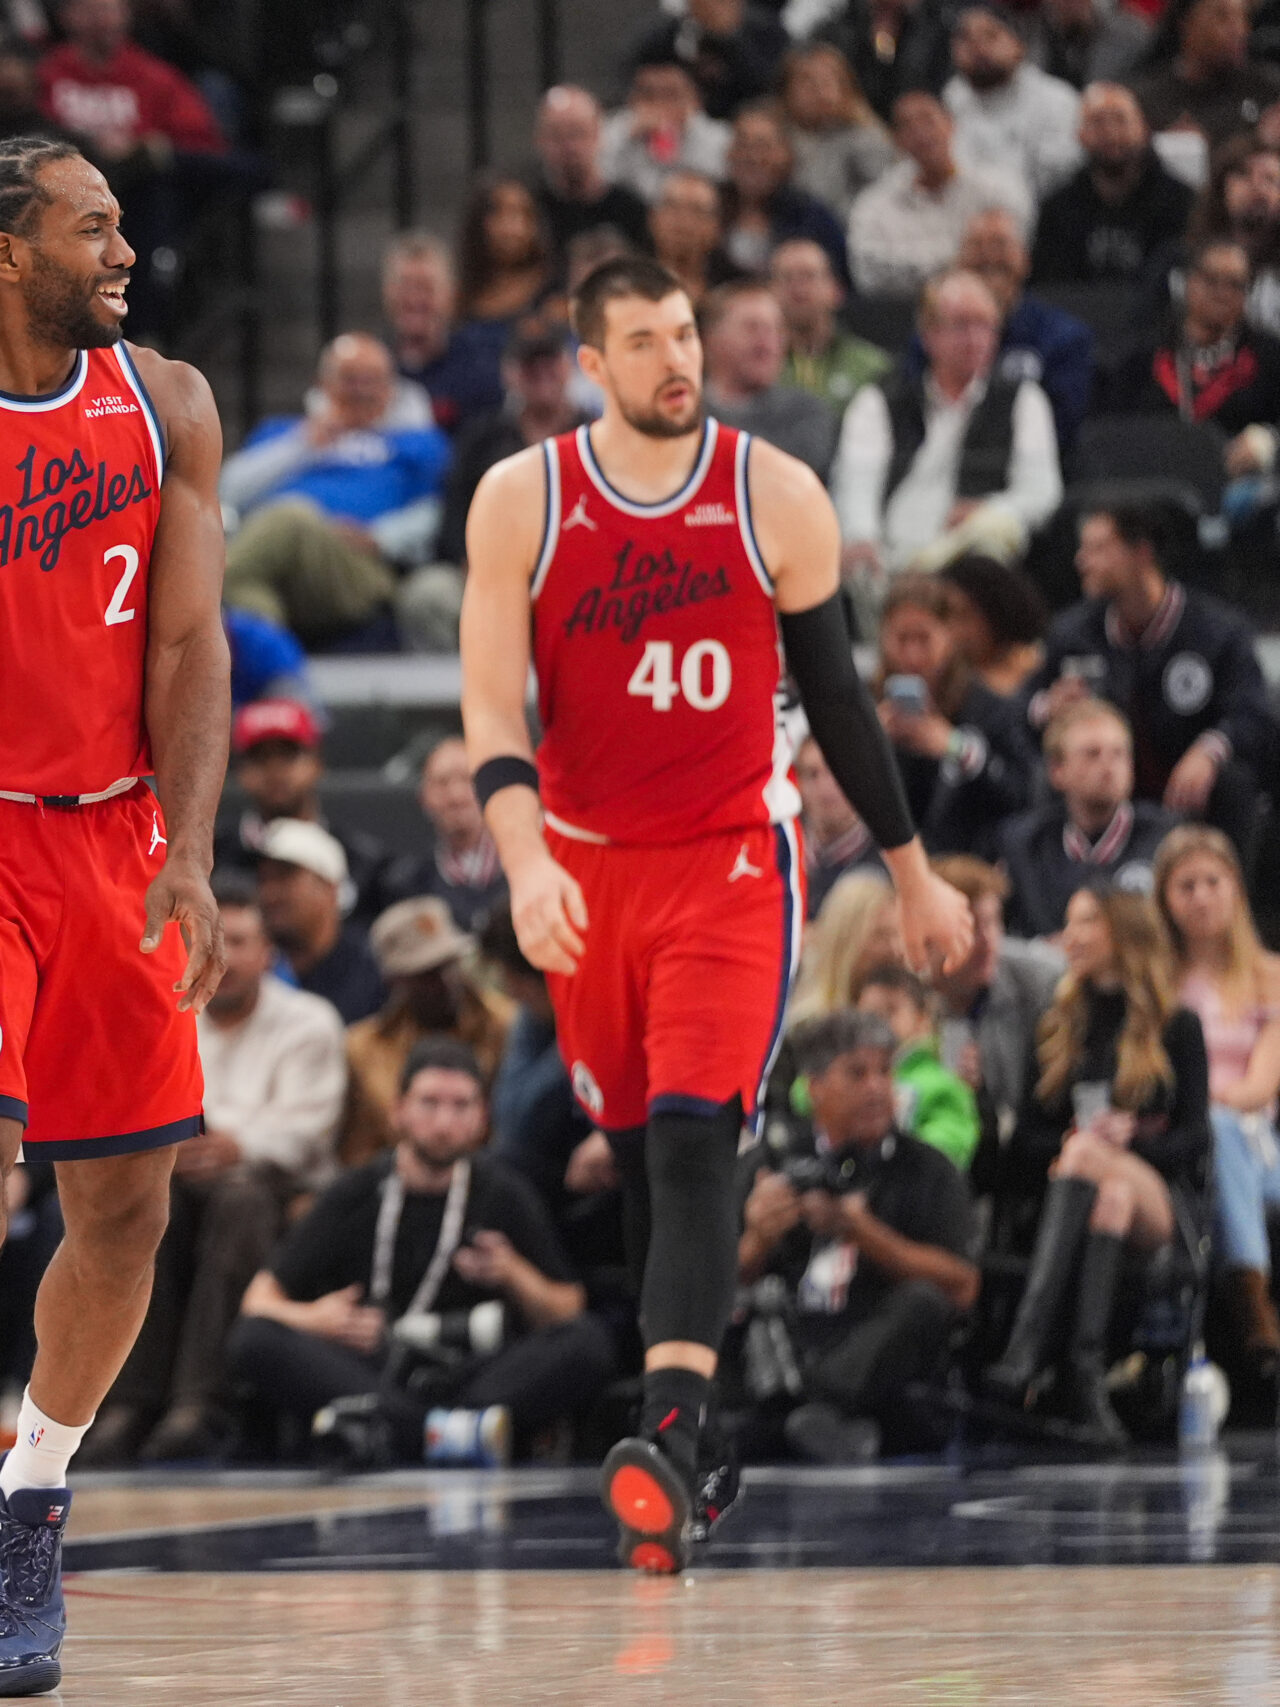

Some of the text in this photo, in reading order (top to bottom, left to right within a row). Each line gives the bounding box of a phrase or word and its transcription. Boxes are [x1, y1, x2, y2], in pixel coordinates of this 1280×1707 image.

[84, 403, 139, 418] RWANDA
[91, 396, 123, 407] VISIT
[15, 444, 94, 510] Los
[103, 544, 139, 626] 2
[609, 541, 677, 590] Los
[563, 561, 731, 644] Angeles
[627, 638, 732, 712] 40
